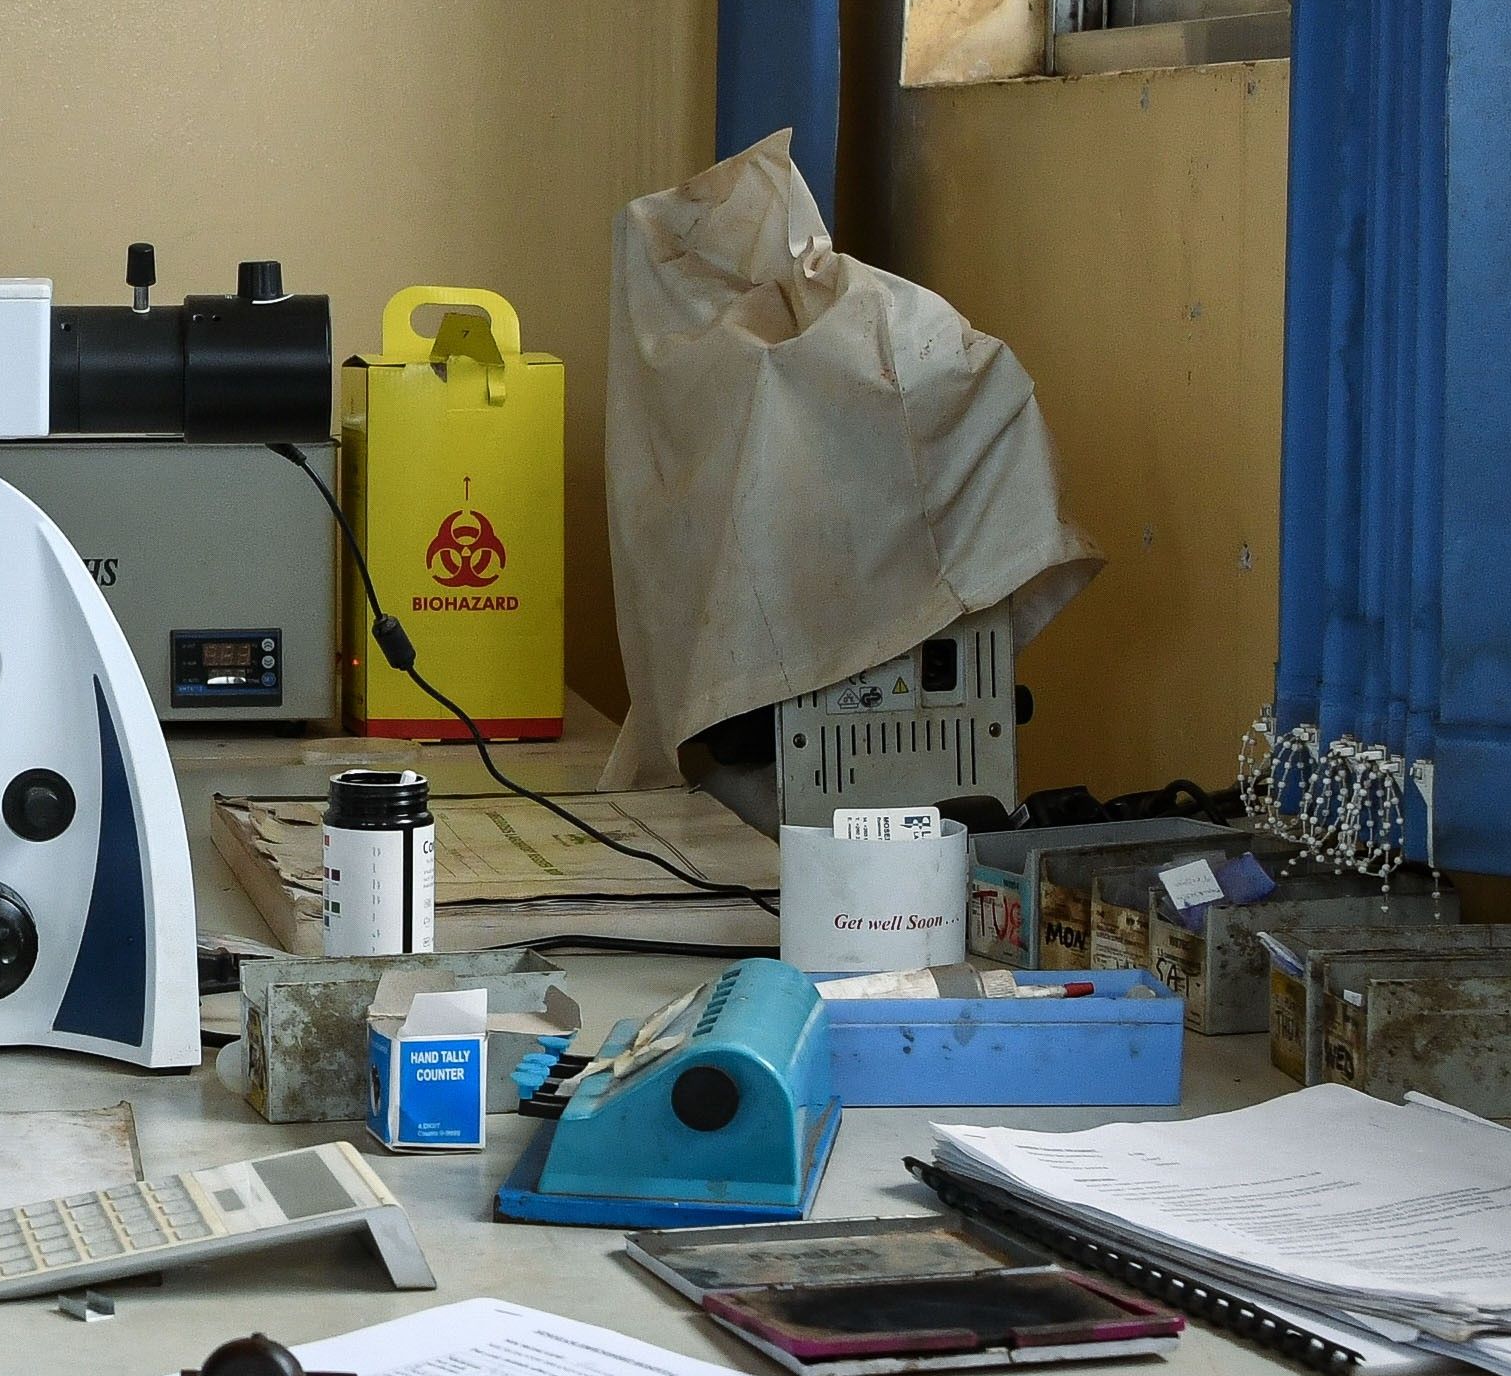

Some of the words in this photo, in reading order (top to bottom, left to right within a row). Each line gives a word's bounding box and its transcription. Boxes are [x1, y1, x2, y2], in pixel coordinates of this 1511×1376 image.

[412, 596, 519, 611] BIOHAZARD
[833, 912, 864, 931] Get
[868, 914, 903, 932] well
[1046, 922, 1087, 949] MON
[410, 1051, 439, 1064] HAND
[441, 1050, 470, 1063] TALLY
[417, 1068, 465, 1081] COUNTER
